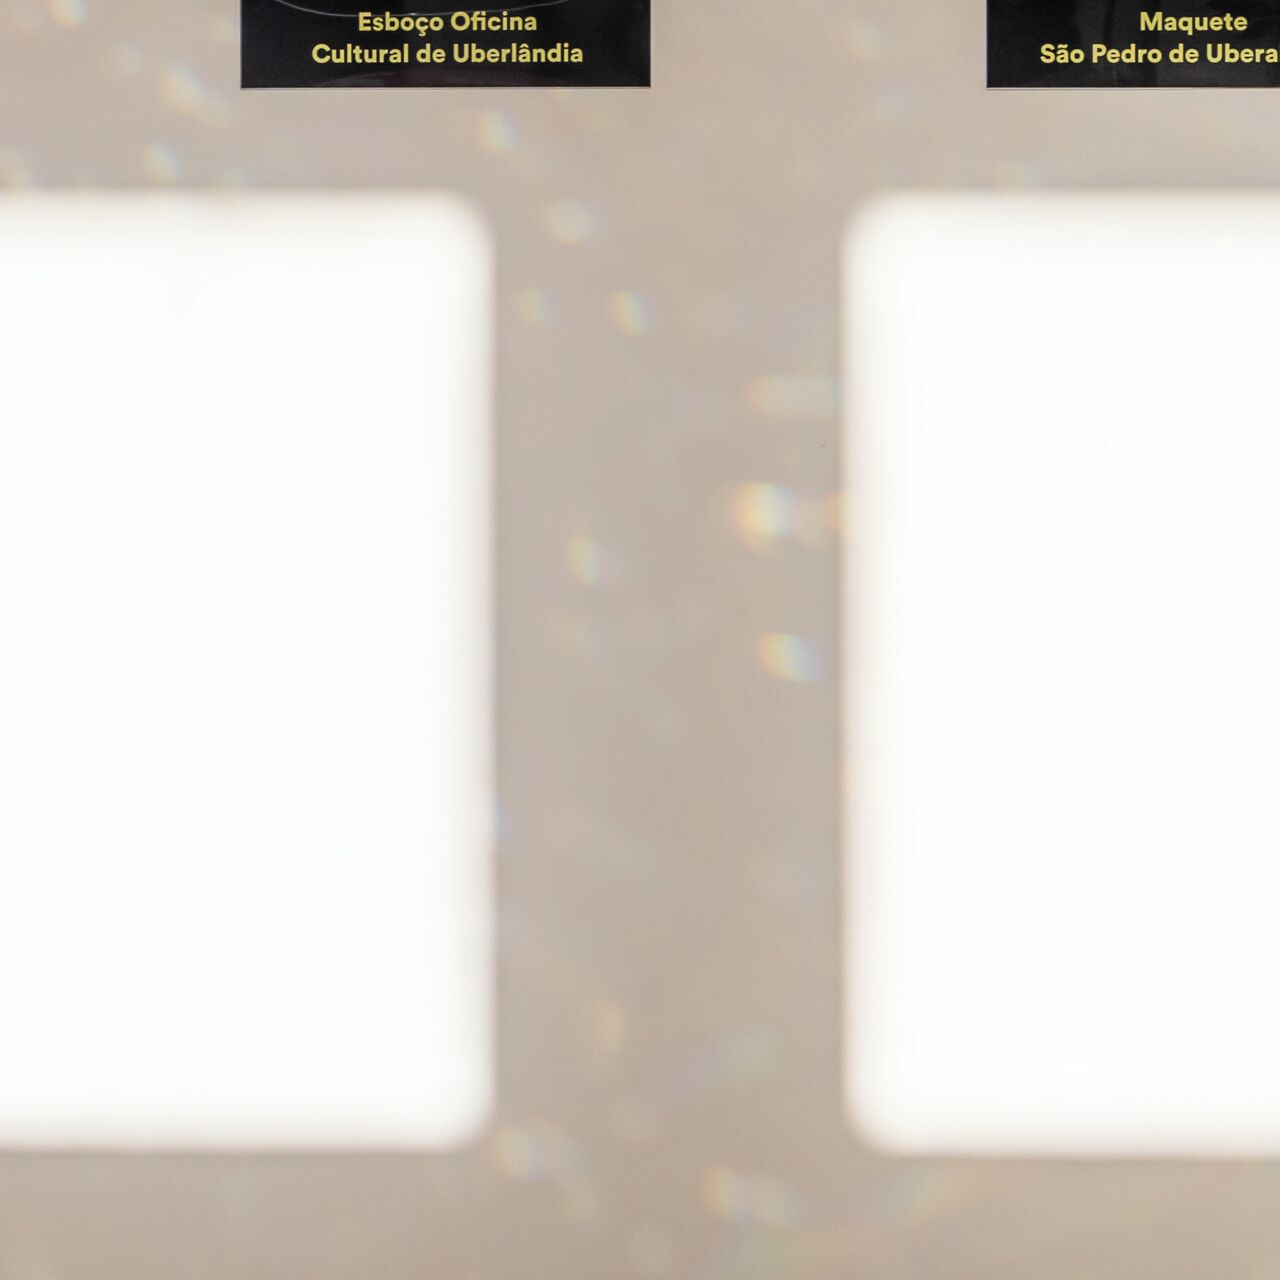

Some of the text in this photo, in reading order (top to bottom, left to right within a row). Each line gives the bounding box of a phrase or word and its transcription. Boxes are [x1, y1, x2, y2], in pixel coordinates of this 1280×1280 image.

[358, 10, 537, 38] Esboço Oficina
[1139, 11, 1249, 37] Maquete
[311, 42, 584, 64] Cultural de Uberlândia
[1040, 42, 1085, 64] São
[1091, 42, 1163, 64] Pedro
[1168, 42, 1200, 64] de
